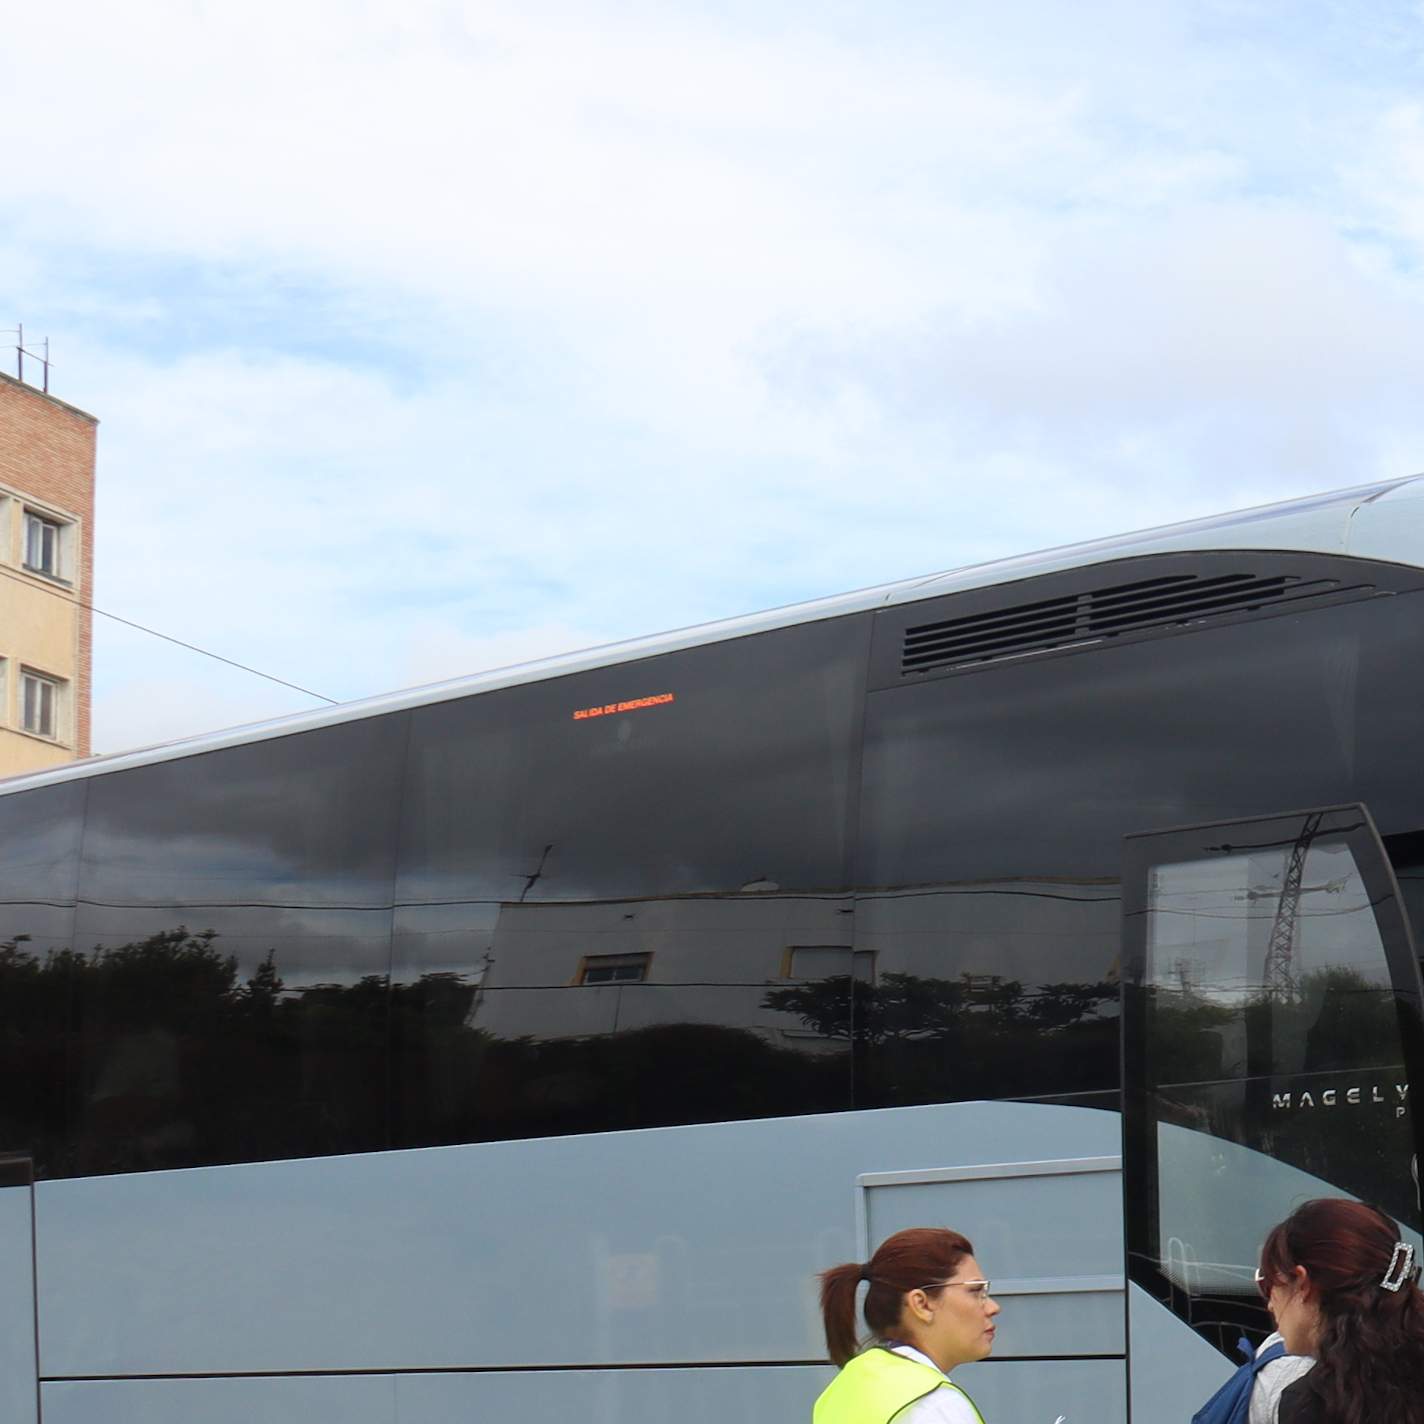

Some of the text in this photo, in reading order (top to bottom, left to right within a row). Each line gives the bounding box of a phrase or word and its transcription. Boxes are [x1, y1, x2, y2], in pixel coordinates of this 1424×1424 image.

[573, 693, 674, 720] SALIDA DE EMERGENCIA
